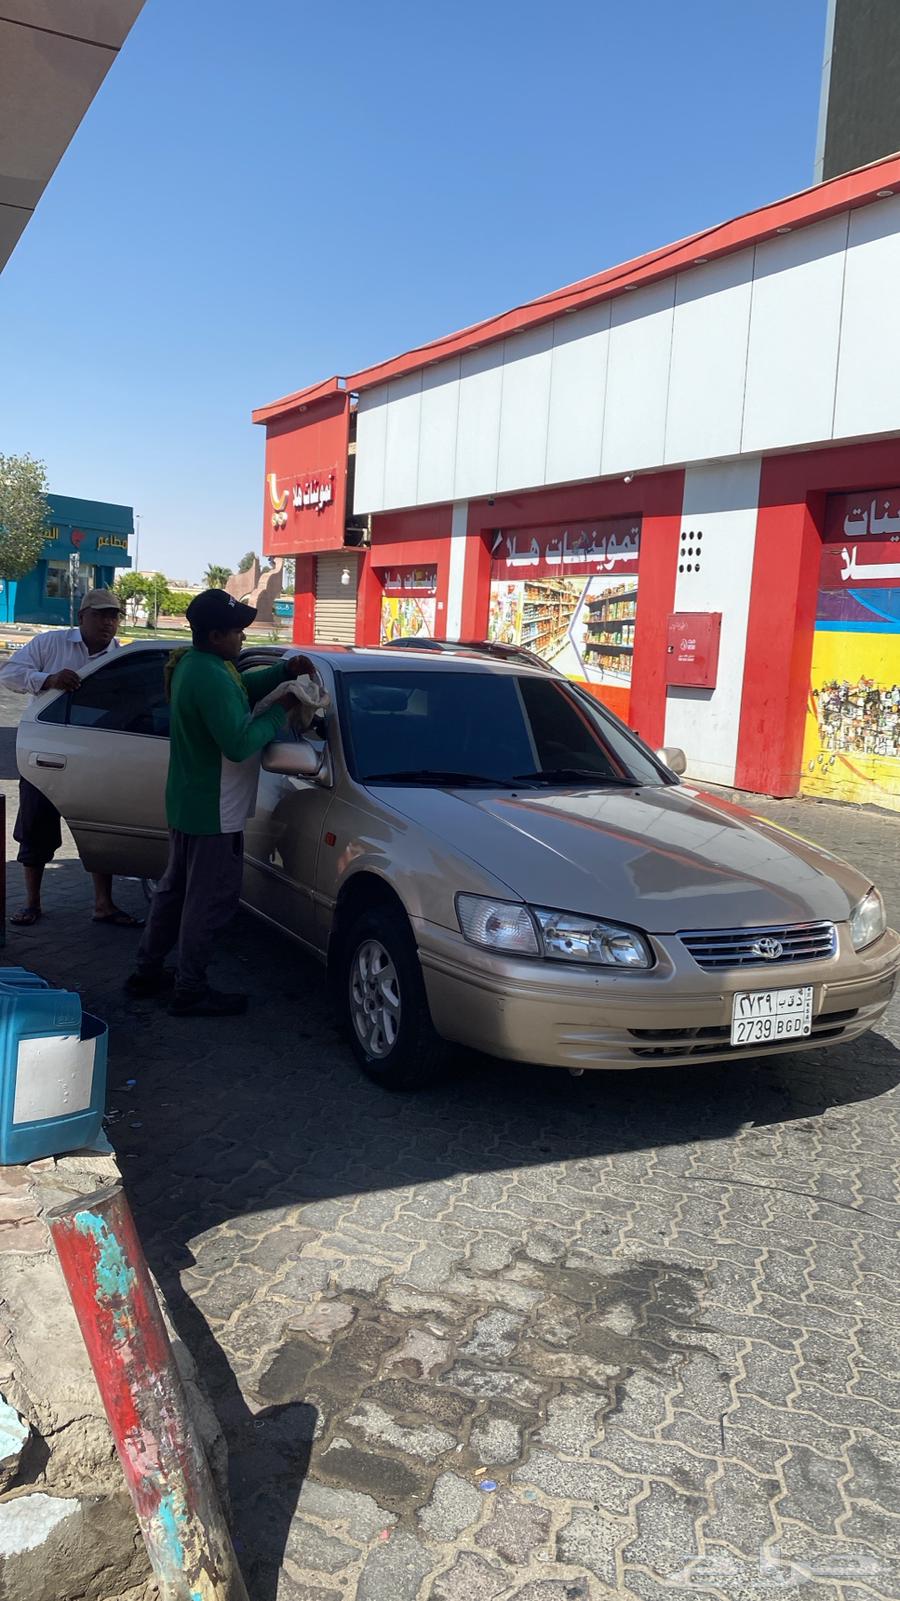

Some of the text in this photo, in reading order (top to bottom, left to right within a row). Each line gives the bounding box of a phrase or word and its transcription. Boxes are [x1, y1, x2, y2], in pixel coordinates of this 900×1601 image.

[292, 474, 333, 511] تموينات هلا
[97, 534, 128, 551] مطاعم
[506, 527, 639, 570] تموينات هلا
[740, 994, 772, 1016] ٢٧٣٩
[737, 1018, 801, 1042] 2739 BGD
